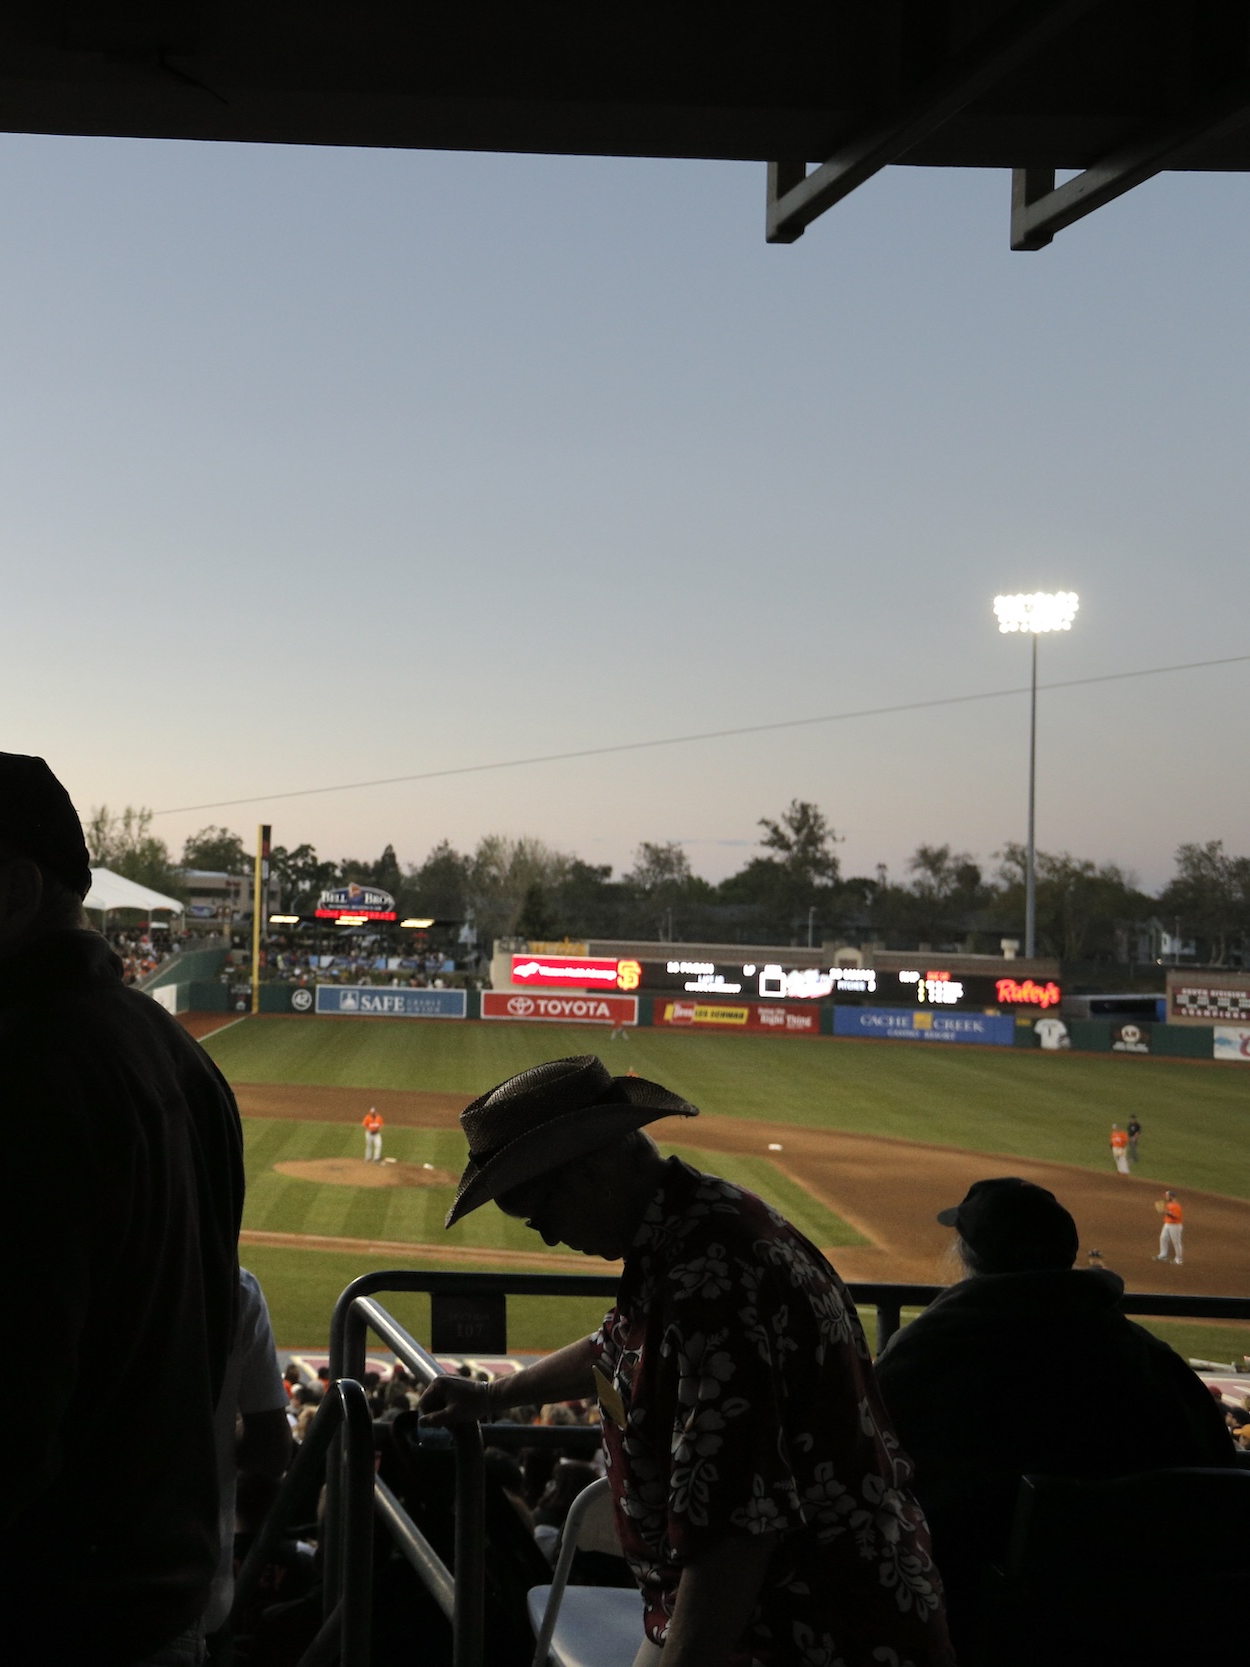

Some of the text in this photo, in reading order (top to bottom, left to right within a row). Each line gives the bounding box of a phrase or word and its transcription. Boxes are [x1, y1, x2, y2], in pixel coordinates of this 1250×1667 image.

[321, 890, 347, 903] BELL
[361, 994, 405, 1012] SAFE
[996, 979, 1061, 1009] Raley's
[537, 1000, 610, 1017] TOYOTA
[860, 1014, 985, 1033] CACHE CREEK
